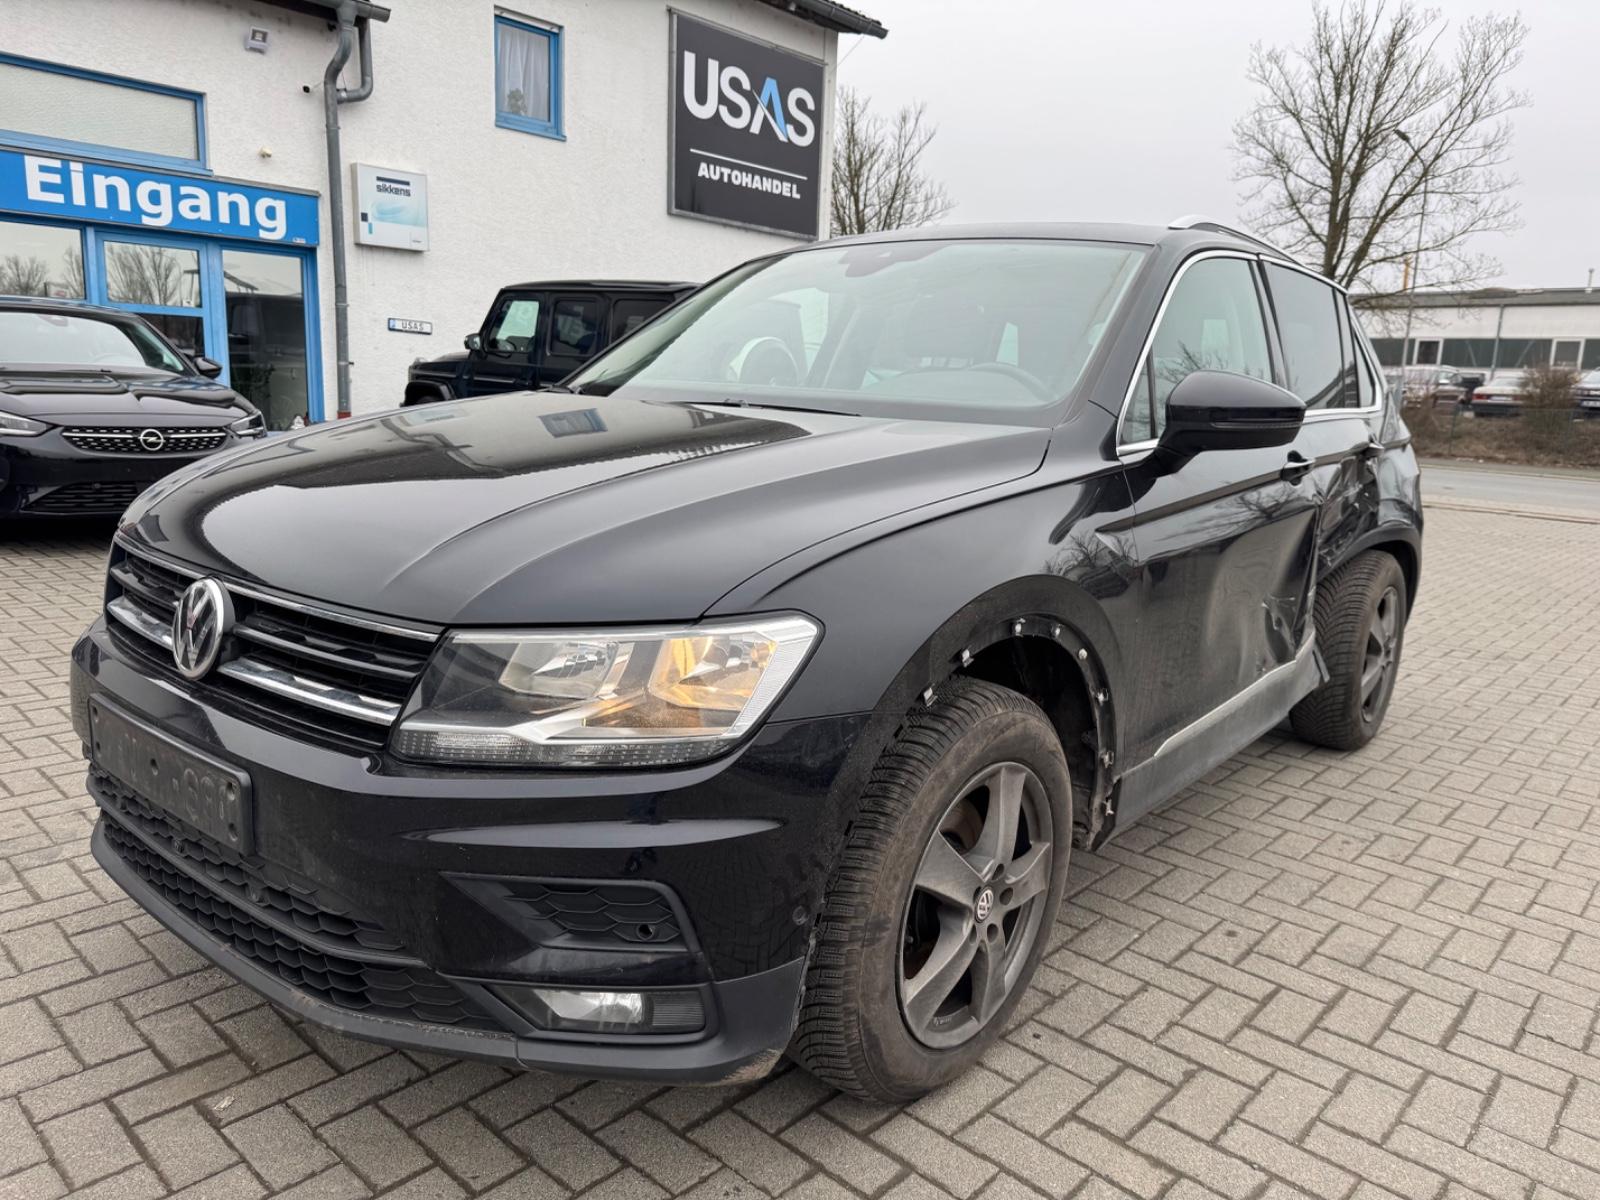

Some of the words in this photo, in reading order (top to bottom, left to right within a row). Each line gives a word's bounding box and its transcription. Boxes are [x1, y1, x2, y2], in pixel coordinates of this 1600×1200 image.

[683, 50, 816, 147] USAS
[24, 155, 287, 240] Eingang
[376, 184, 411, 197] sikkens
[697, 162, 801, 199] AUTOHANDEL
